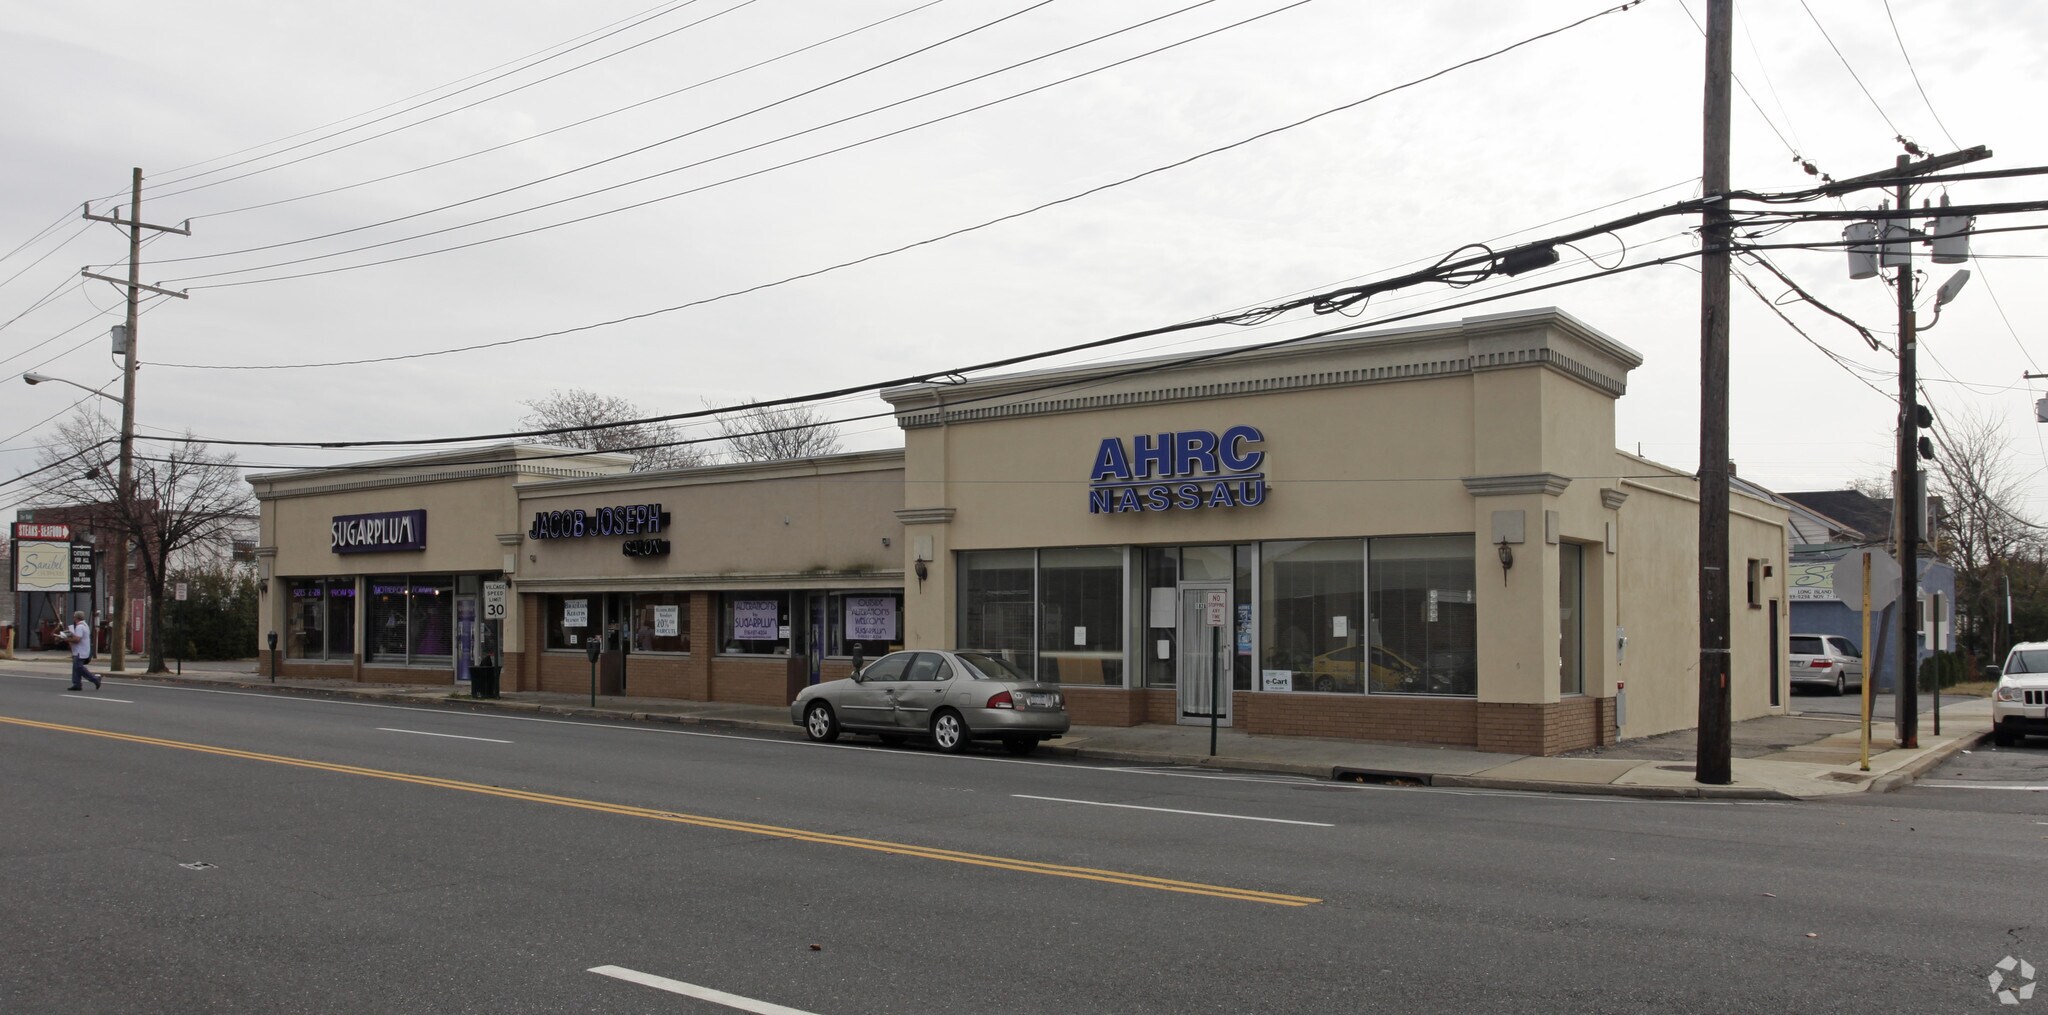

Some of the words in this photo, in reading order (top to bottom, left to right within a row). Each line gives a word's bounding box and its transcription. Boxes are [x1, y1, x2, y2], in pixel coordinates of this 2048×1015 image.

[1089, 425, 1264, 481] AHRC
[1089, 480, 1266, 514] NASSAU
[528, 509, 587, 540] JACOB
[590, 503, 662, 538] JOSEPH
[18, 524, 39, 537] STEAKS
[41, 525, 63, 538] SEAFOOD
[331, 516, 415, 547] SUGARPLUM
[623, 540, 662, 557] SALON
[21, 553, 67, 577] Sanibel
[487, 604, 505, 616] 30
[735, 601, 777, 611] ALTERATIONS
[851, 608, 890, 616] ALTERATIONS
[656, 618, 669, 628] 20%
[735, 617, 778, 628] SUGARPLUM
[854, 617, 886, 625] WELCOME
[854, 627, 887, 635] SUGARPLUM
[1265, 677, 1288, 685] e-Cart
